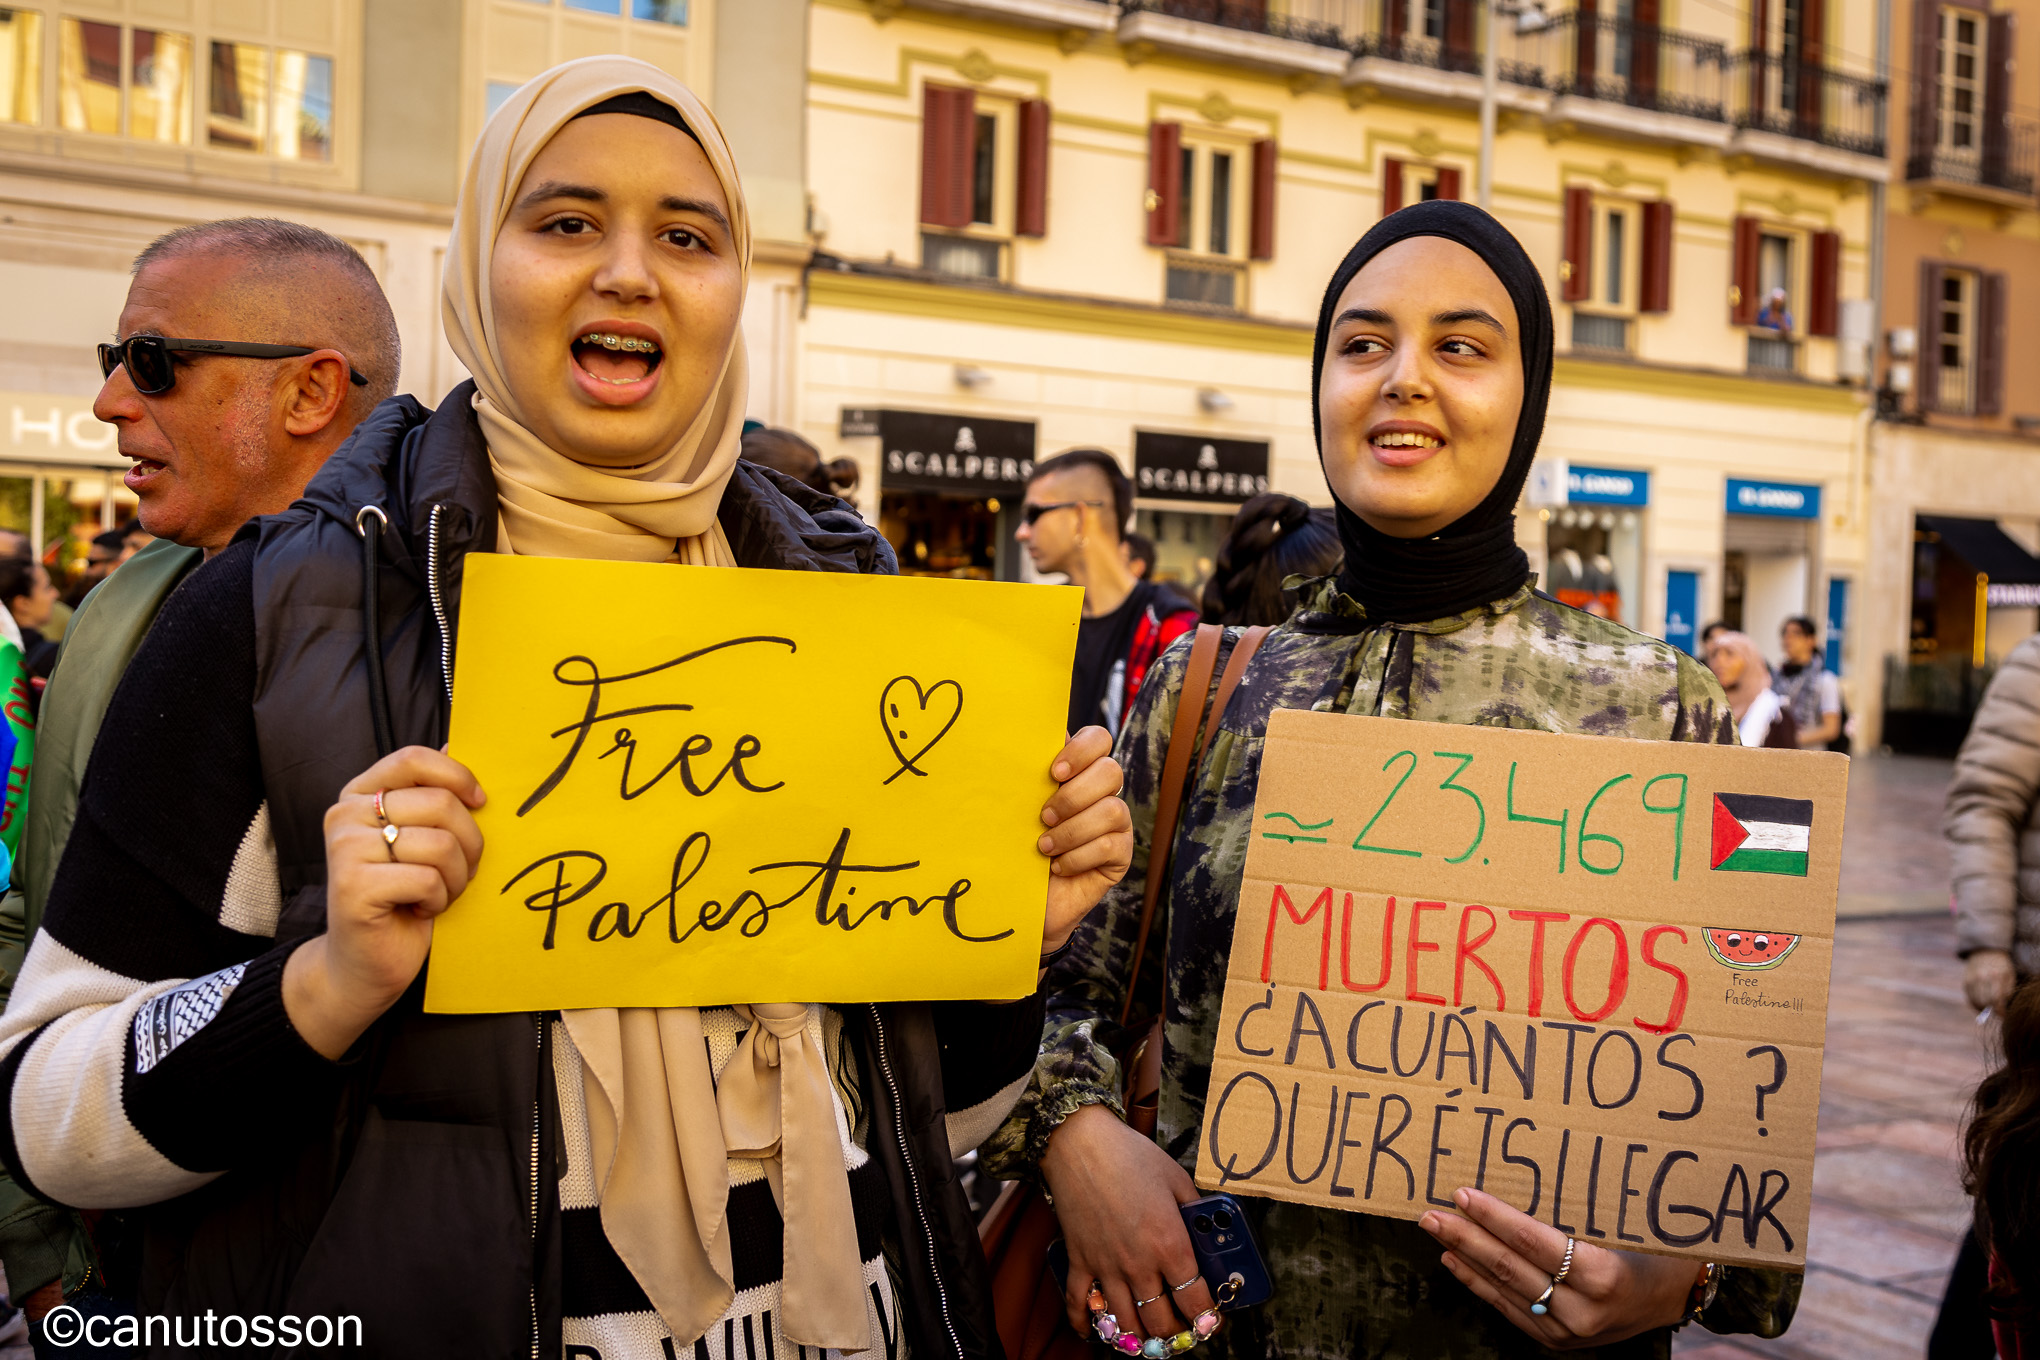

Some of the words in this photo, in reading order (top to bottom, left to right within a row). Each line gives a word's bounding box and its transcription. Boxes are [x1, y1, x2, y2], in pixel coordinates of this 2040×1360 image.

[887, 449, 1034, 482] SCALPERS
[1138, 466, 1269, 498] SCALPERS
[517, 636, 797, 818] Free
[1352, 750, 1689, 882] 23.469
[501, 827, 1015, 951] Palestine
[1260, 884, 1689, 1036] MUERTOS
[1733, 972, 1759, 987] Free
[1552, 1126, 1795, 1252] LLEGAR
